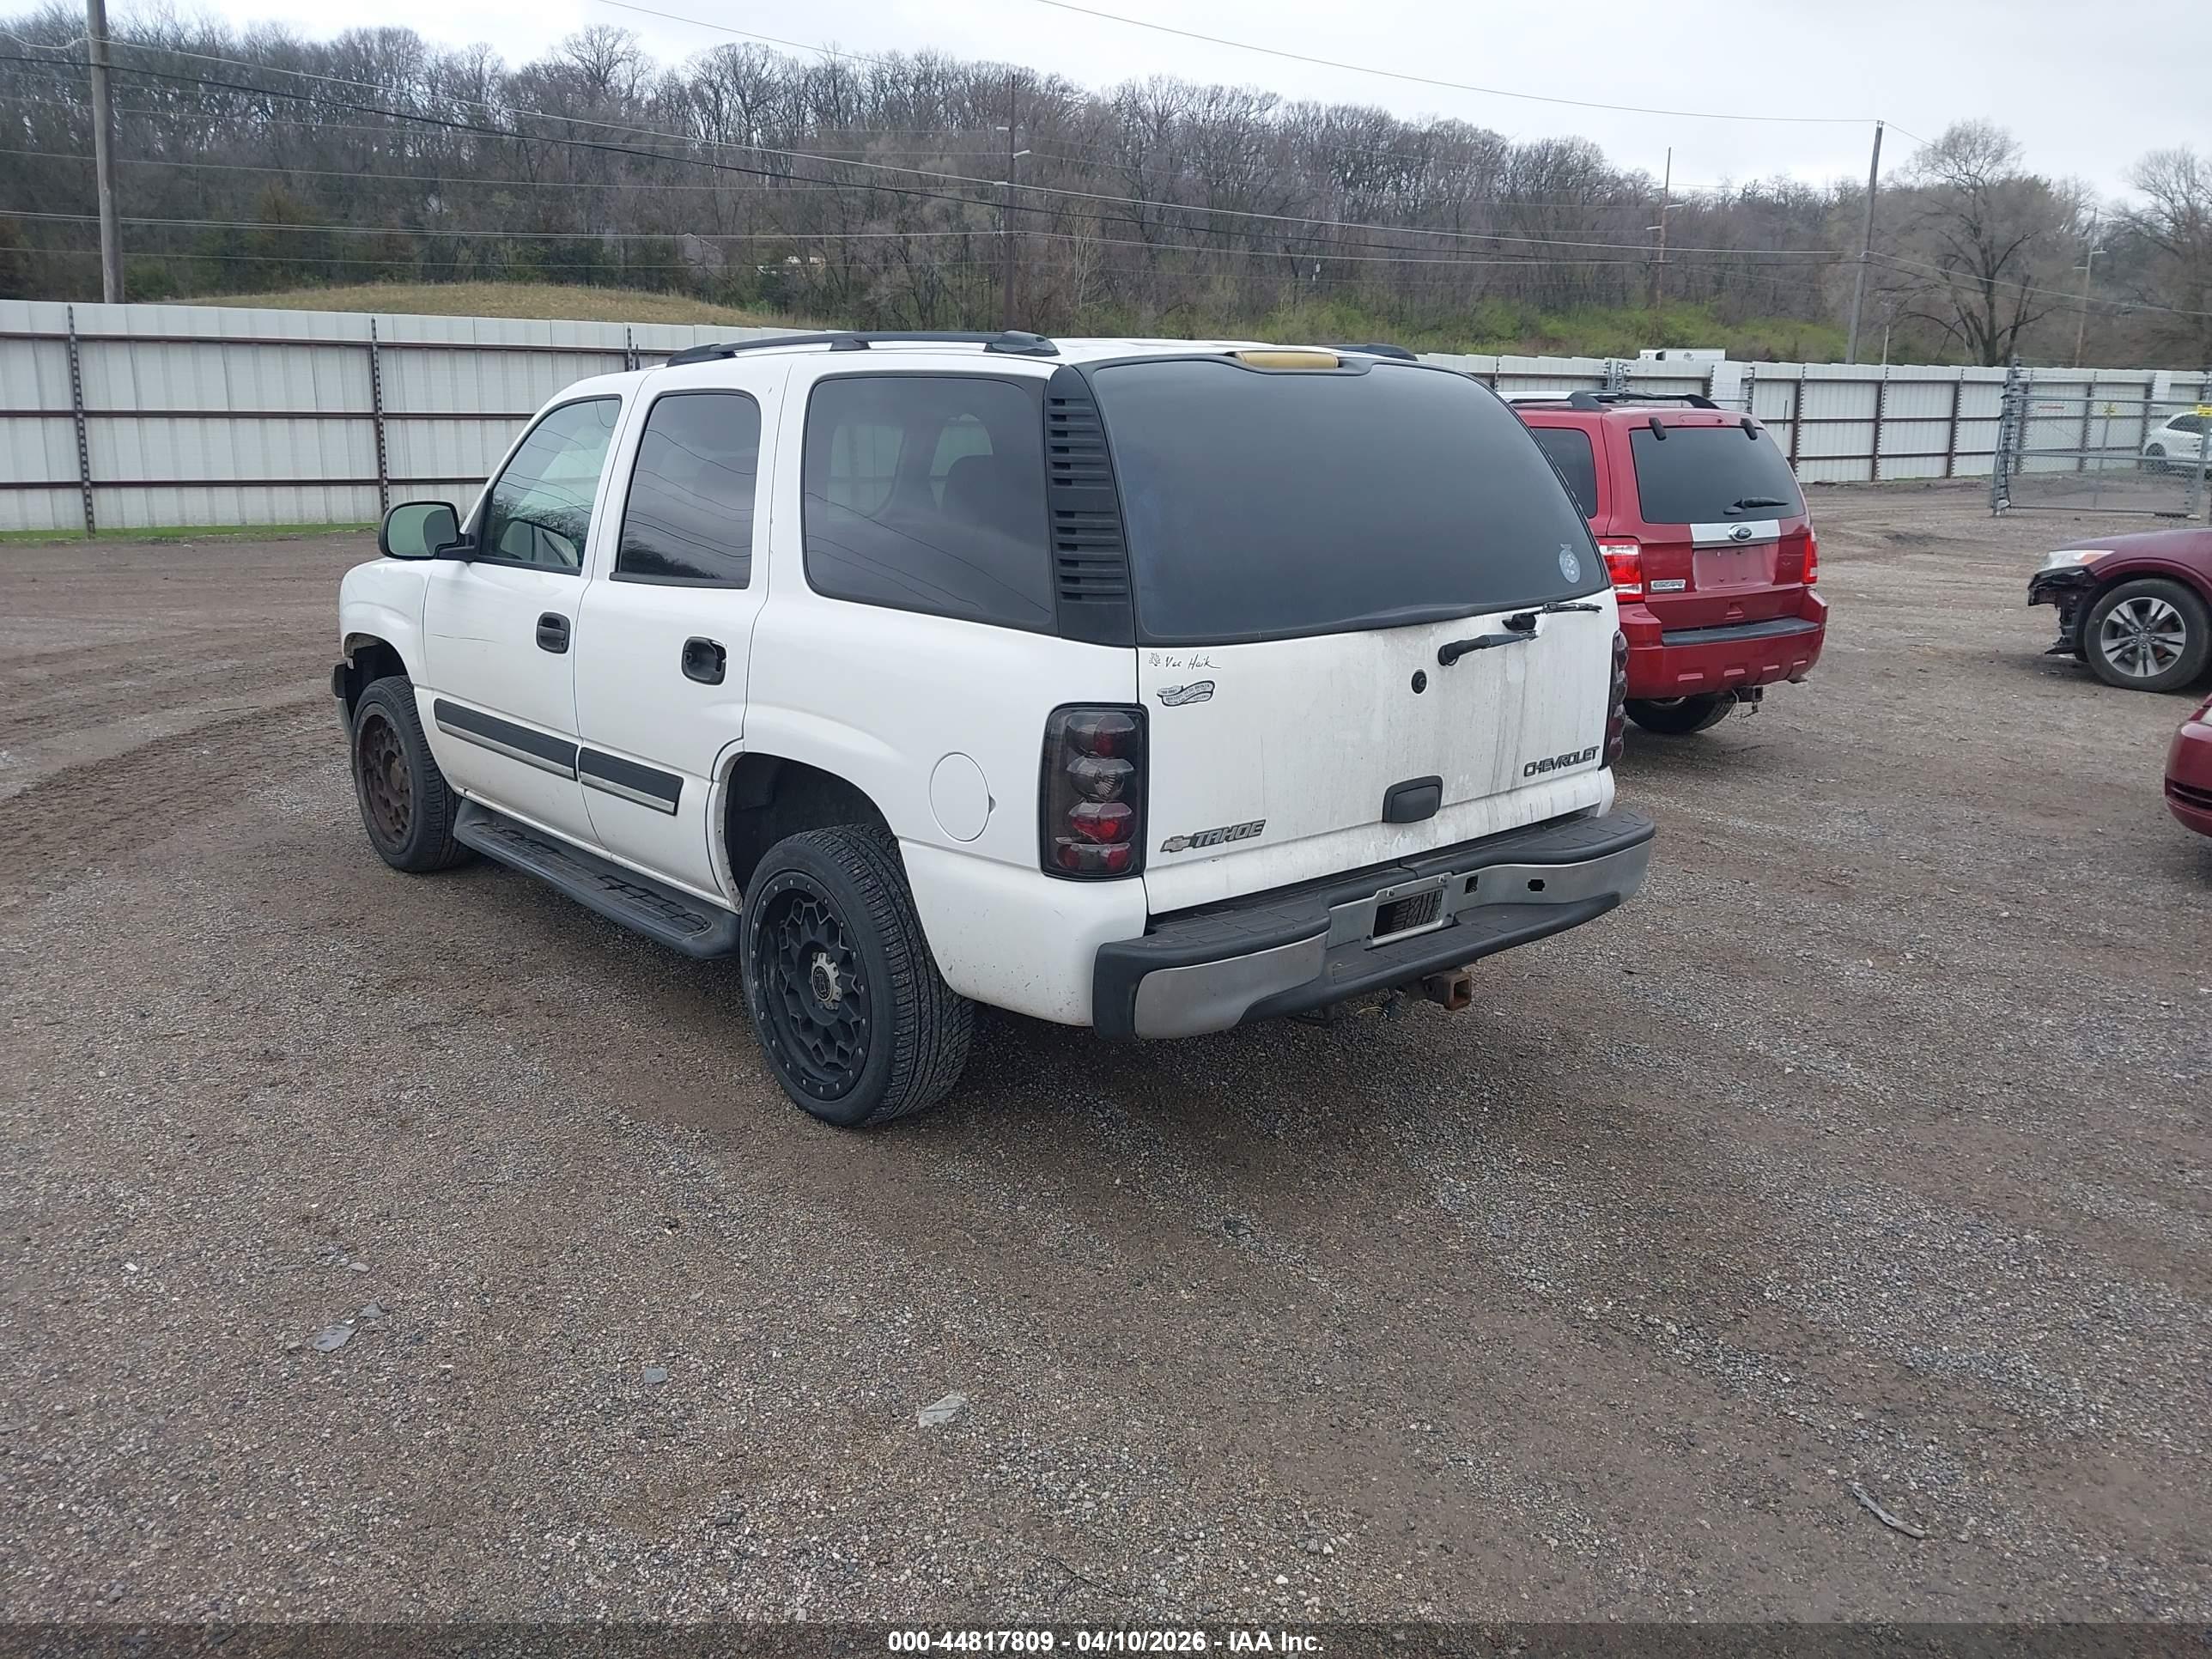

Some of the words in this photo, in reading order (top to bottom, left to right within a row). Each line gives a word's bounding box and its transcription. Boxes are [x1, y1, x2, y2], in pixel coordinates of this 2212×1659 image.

[1188, 653, 1221, 670] Haik
[1523, 745, 1600, 777] CHEVROLET
[1192, 819, 1266, 848] TAHOE
